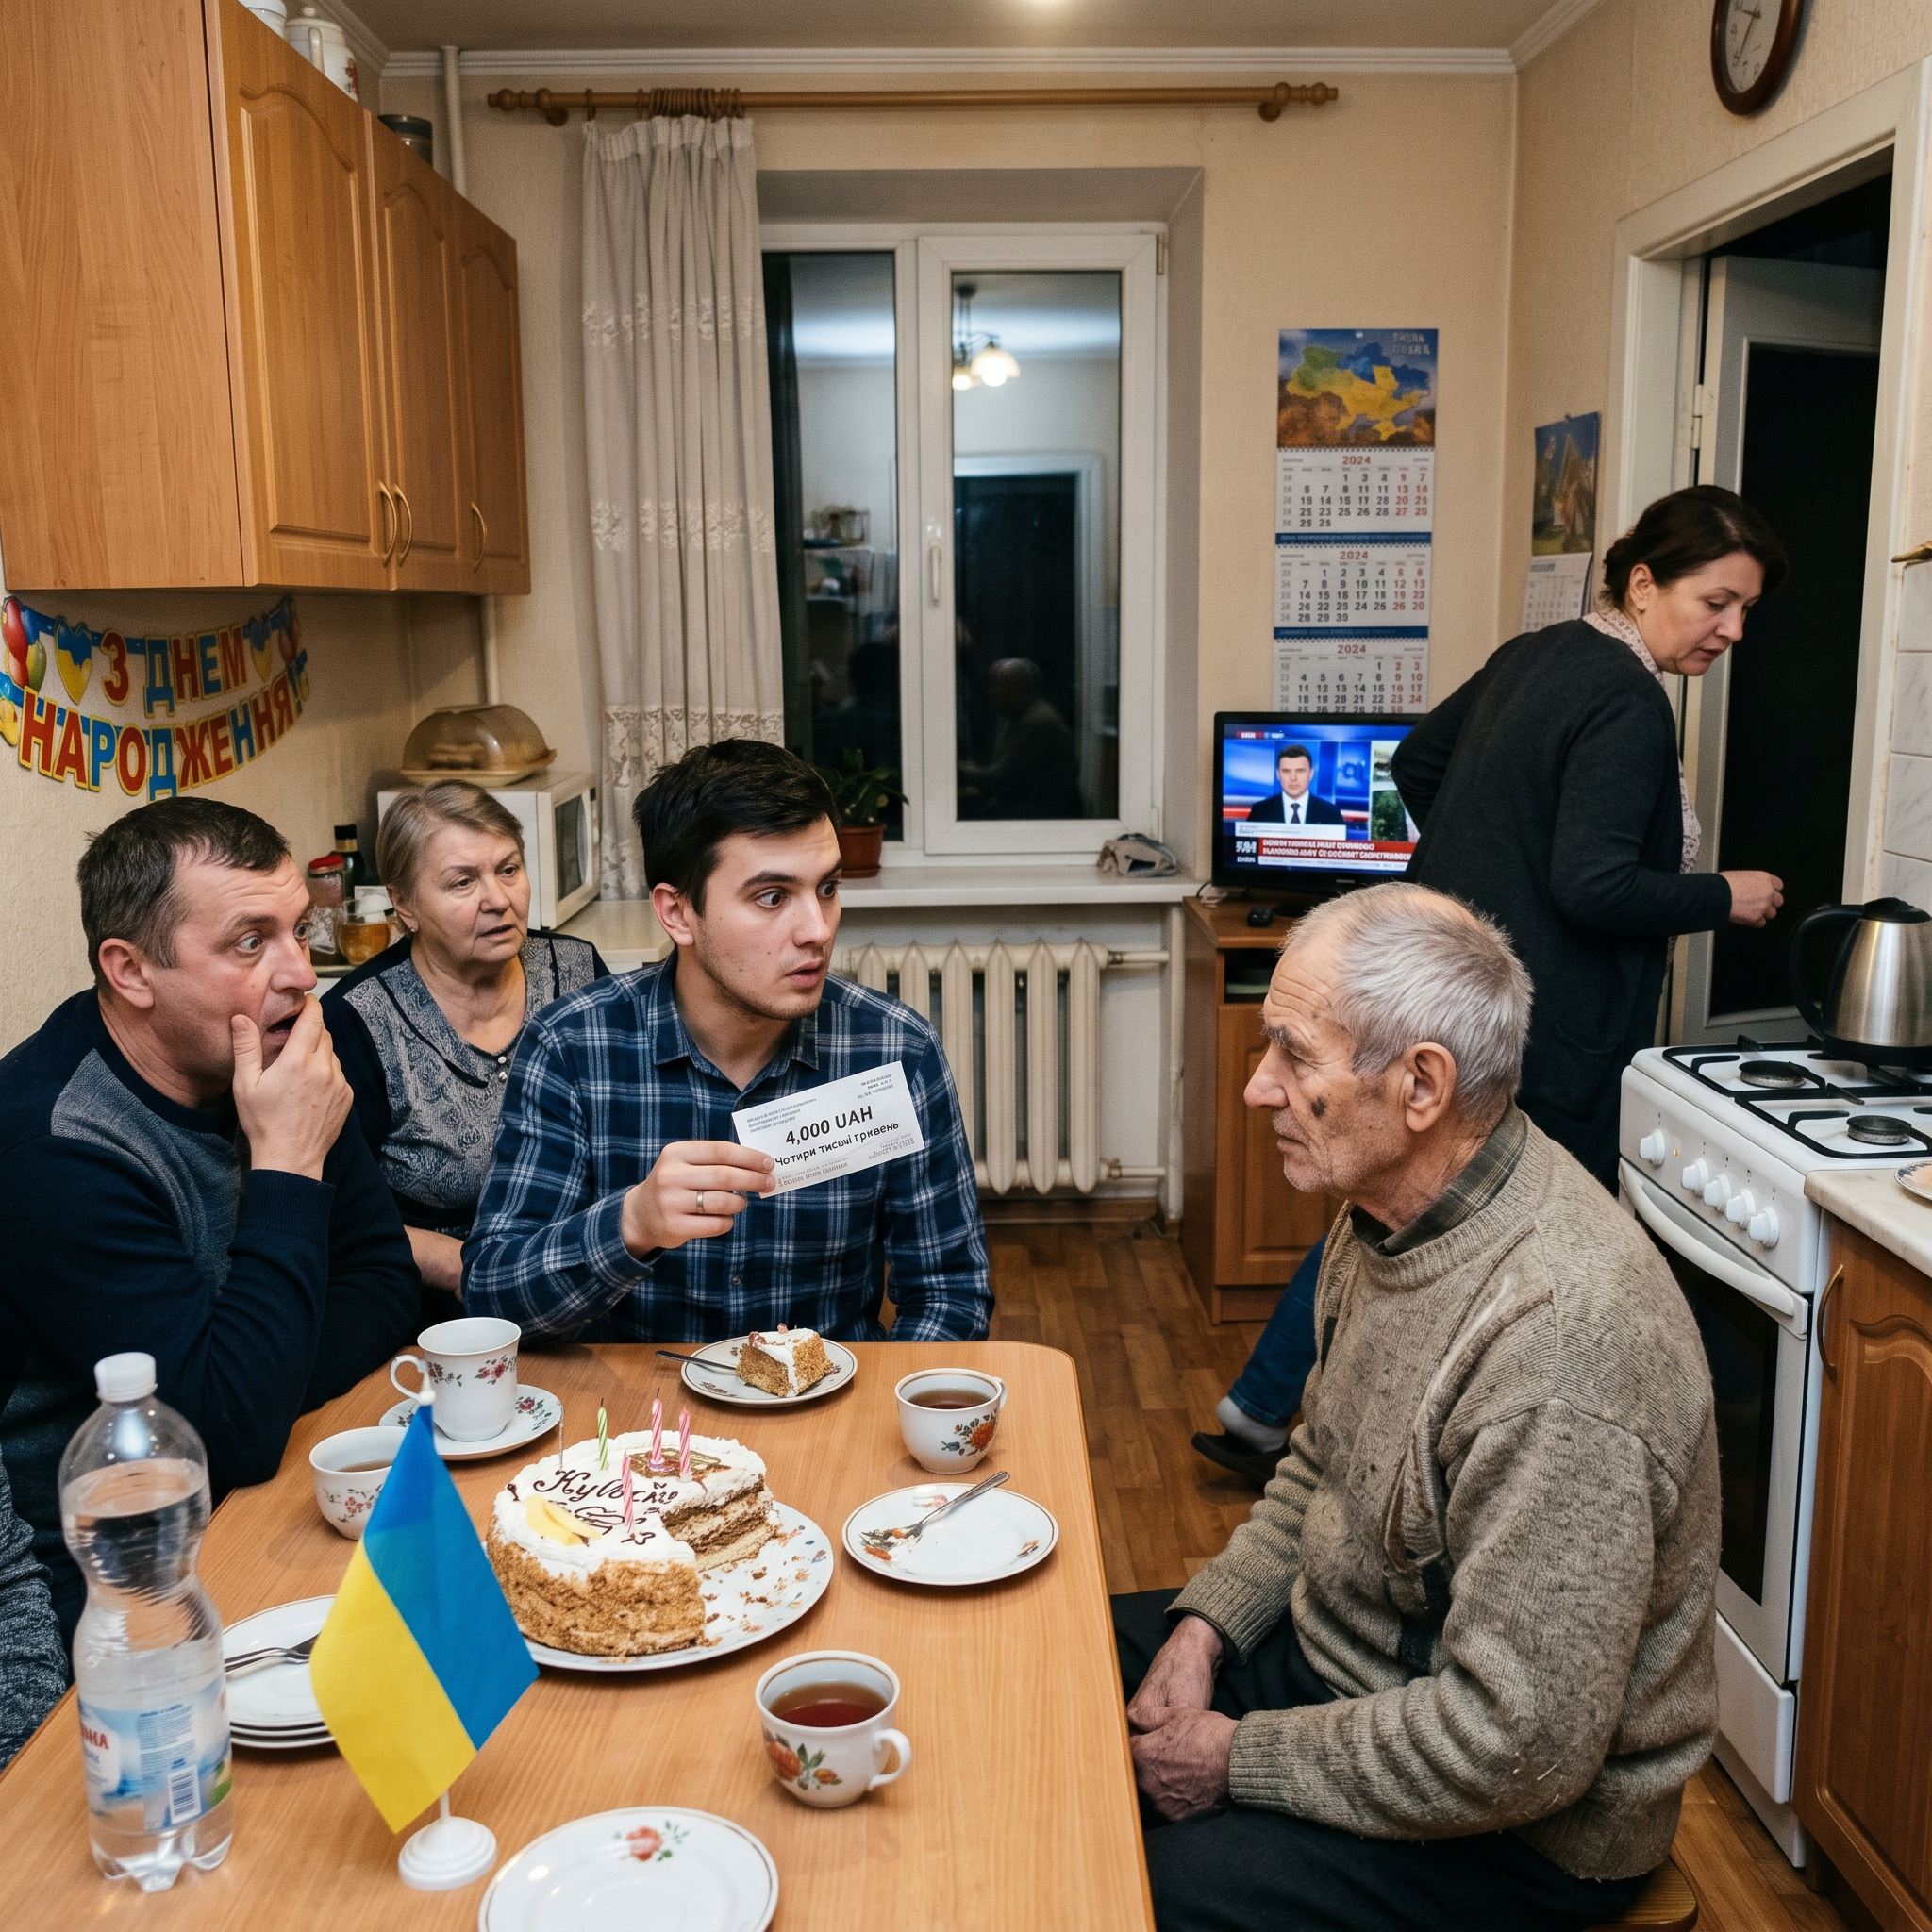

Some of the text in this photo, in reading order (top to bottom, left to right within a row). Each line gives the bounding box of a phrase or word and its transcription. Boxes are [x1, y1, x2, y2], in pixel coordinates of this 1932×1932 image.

[1342, 456, 1371, 465] 2024
[1340, 551, 1369, 560] 2024
[1323, 569, 1326, 577] 1
[1341, 568, 1346, 577] 2
[1303, 579, 1308, 589] 7
[1338, 644, 1367, 654] 2024
[100, 624, 248, 718] З ДНЕМ
[785, 1119, 830, 1145] 4,000
[835, 1106, 874, 1129] UAH
[775, 1147, 817, 1167] Чотири
